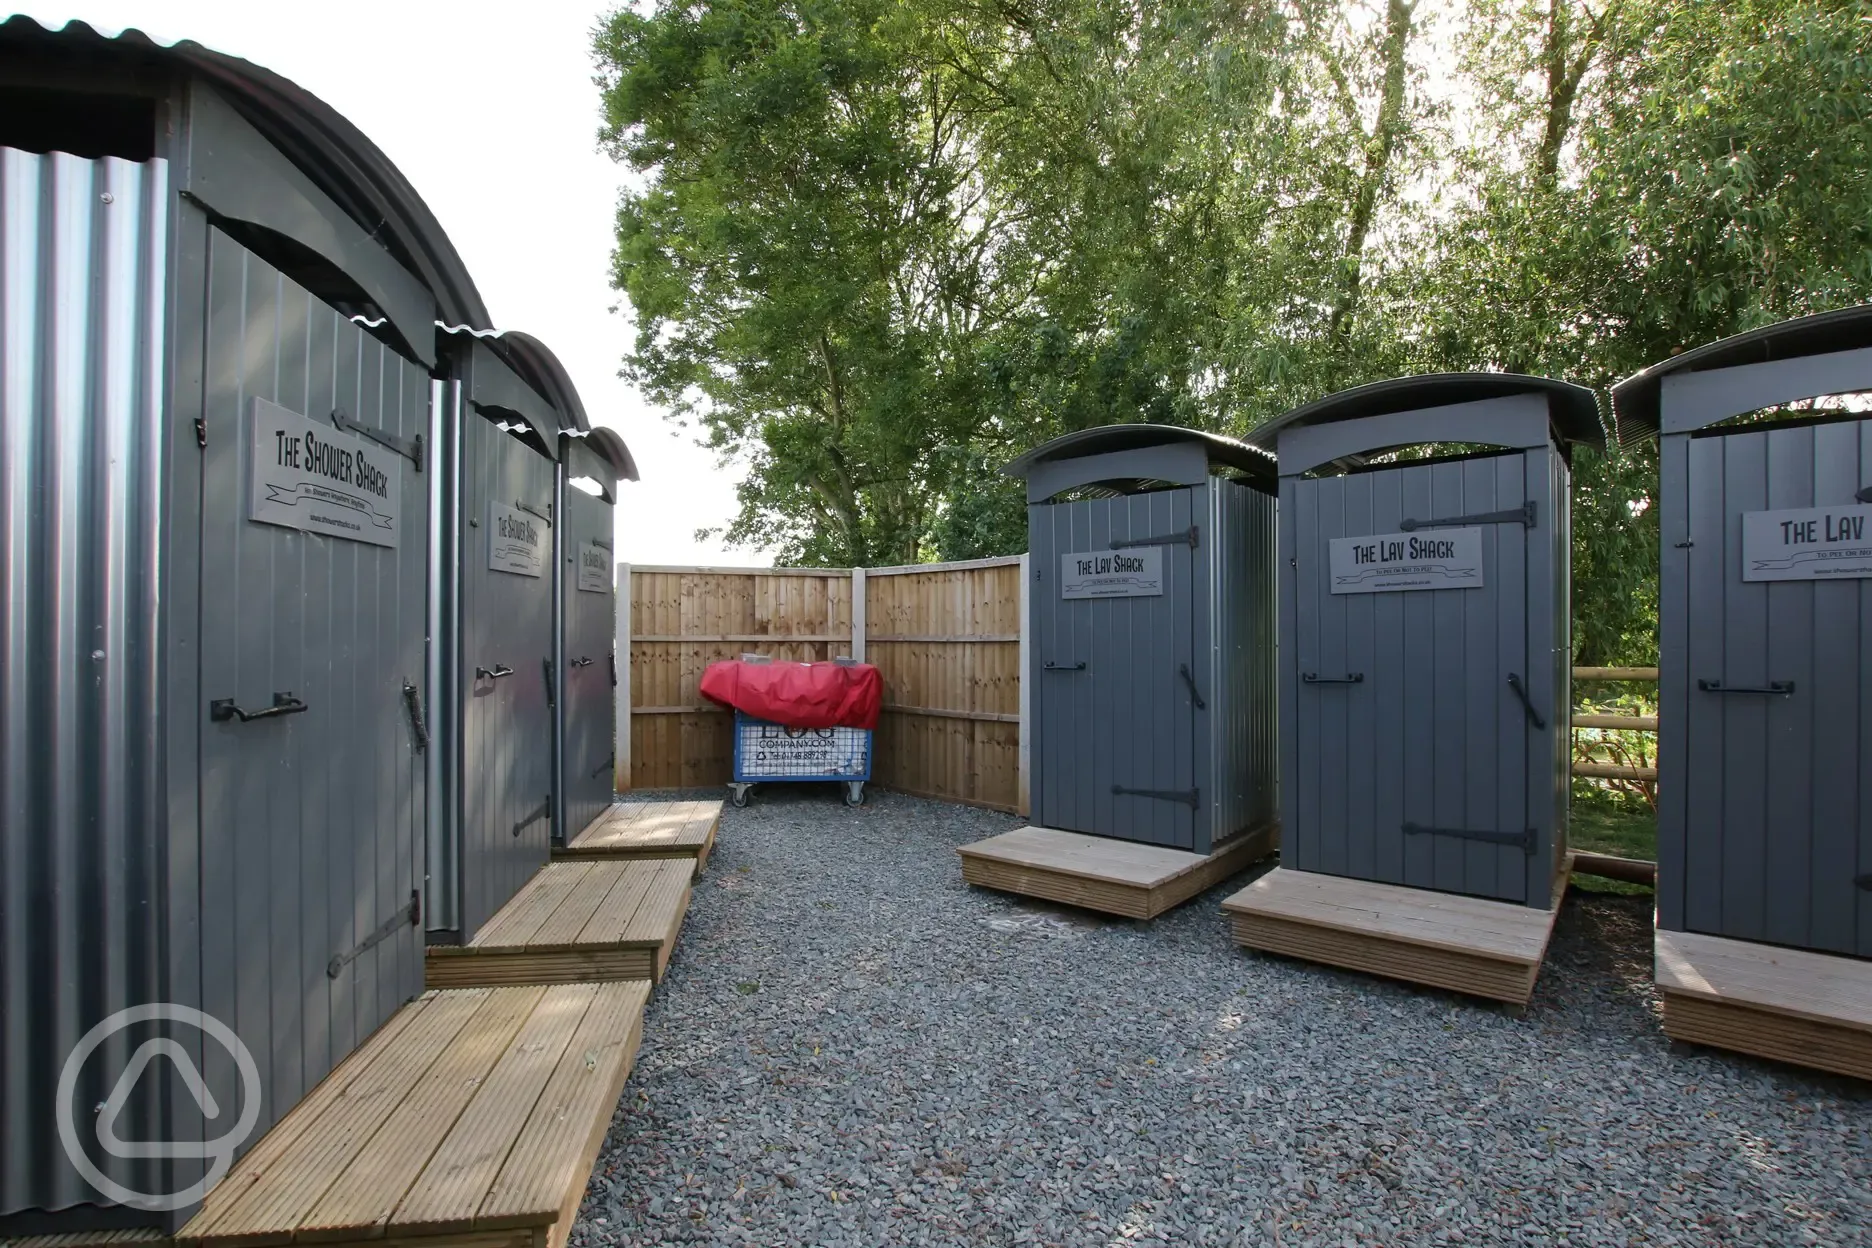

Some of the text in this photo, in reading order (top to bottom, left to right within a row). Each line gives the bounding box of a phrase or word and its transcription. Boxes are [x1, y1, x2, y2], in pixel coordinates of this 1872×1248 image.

[276, 430, 388, 499] THE SHOWER SHACK
[1780, 515, 1865, 545] THE LAV
[1077, 554, 1144, 576] THE LAV SHACK
[1353, 536, 1455, 565] THE LAV SHACK
